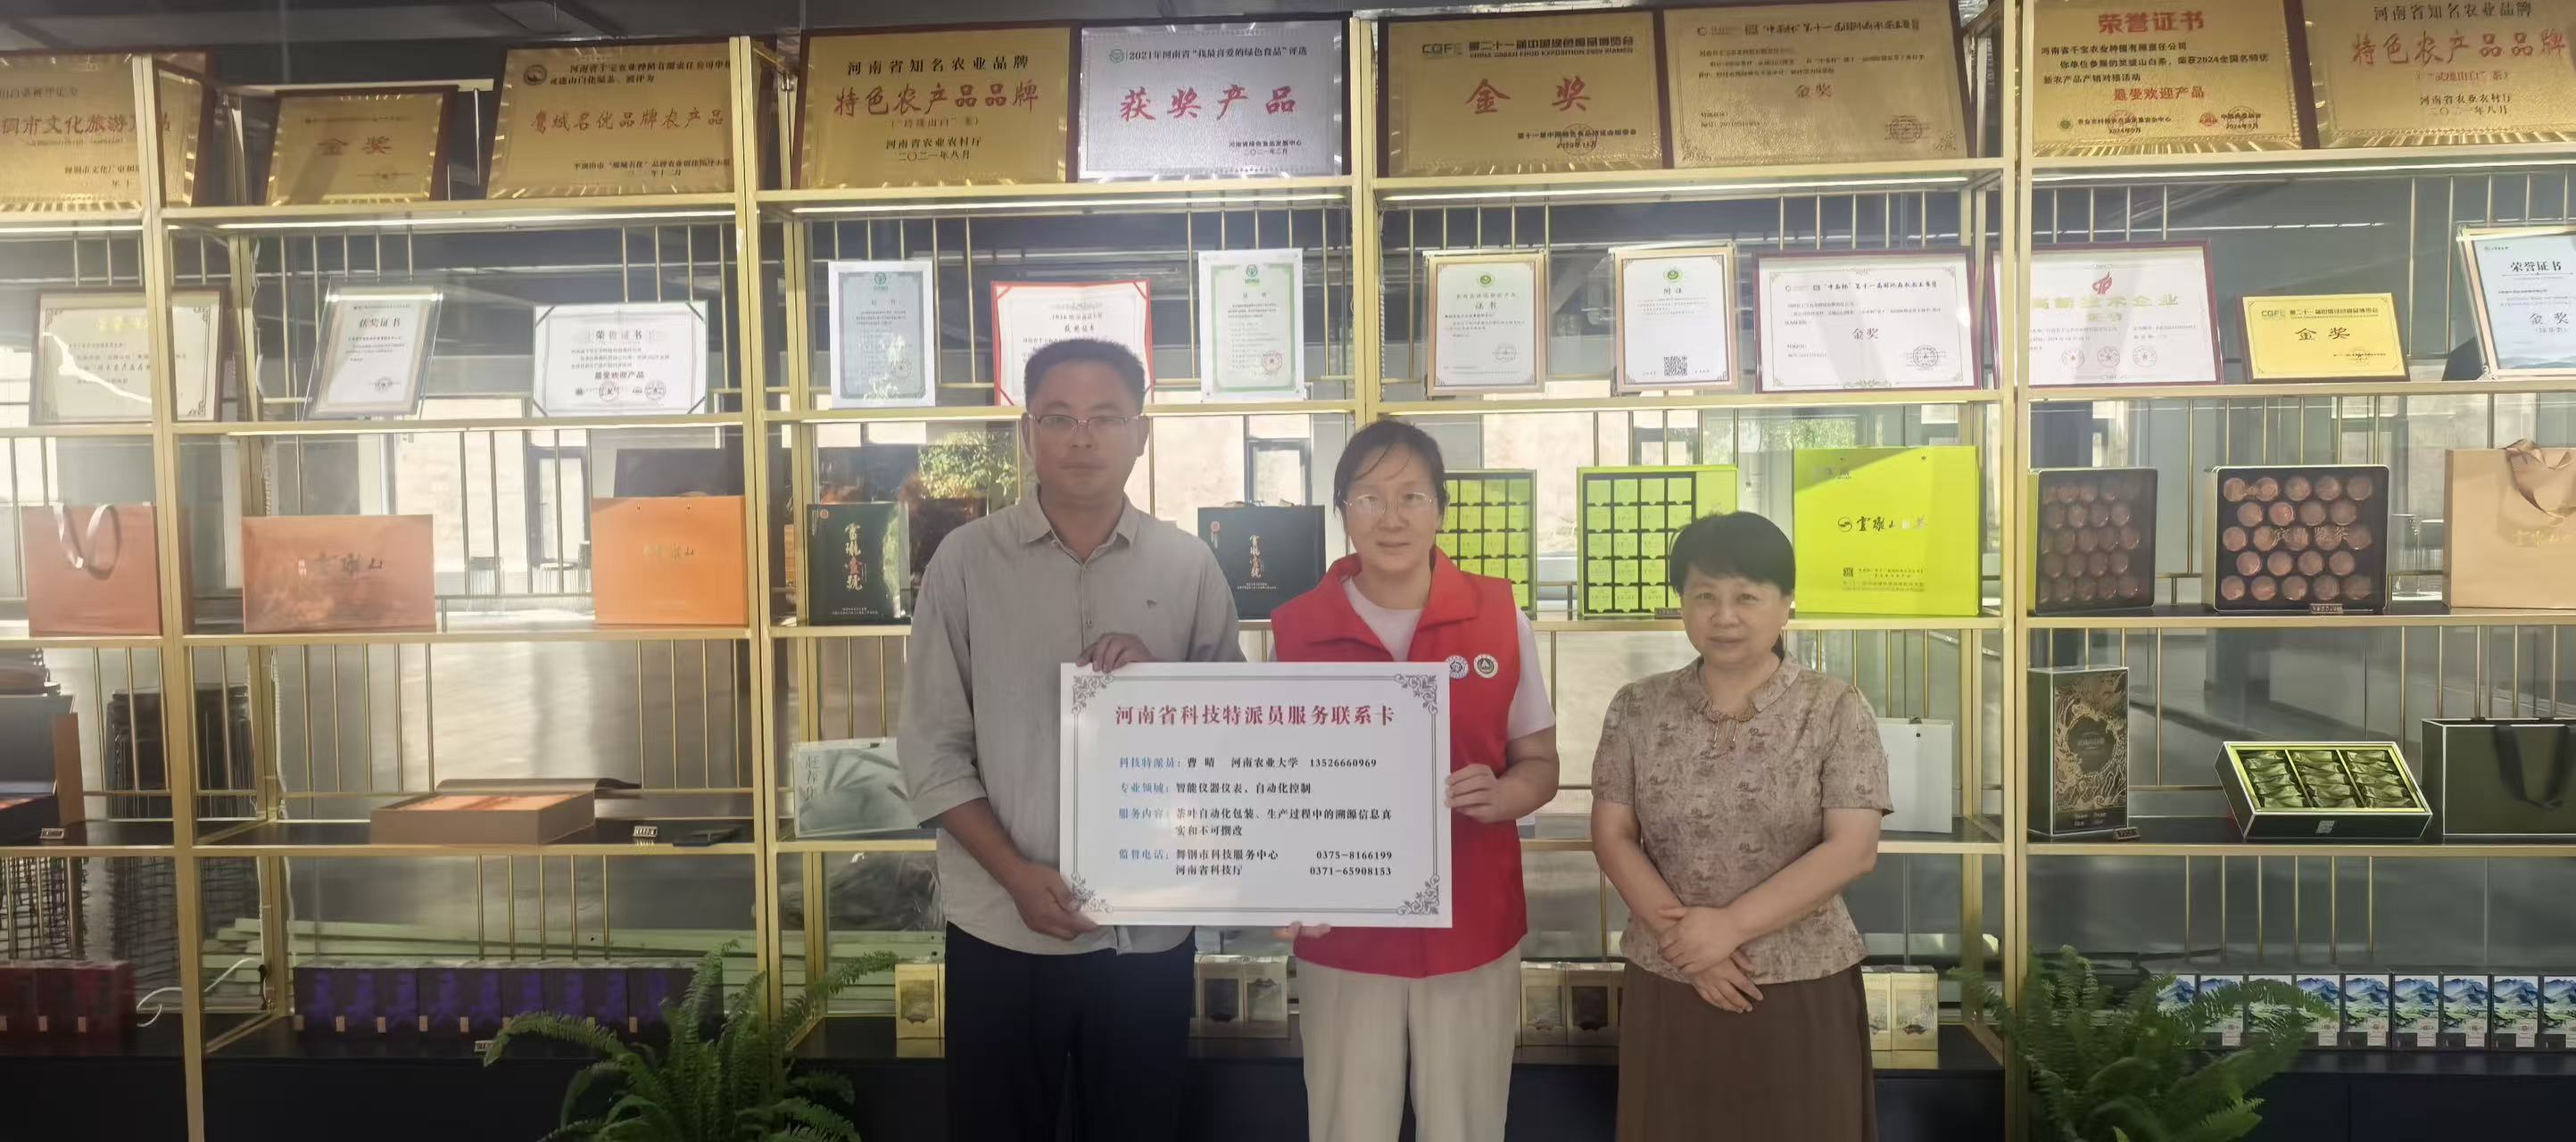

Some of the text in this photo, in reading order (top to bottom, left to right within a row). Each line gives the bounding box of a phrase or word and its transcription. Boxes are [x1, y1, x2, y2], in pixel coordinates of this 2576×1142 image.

[2373, 2, 2532, 21] 河南省知名农业品牌
[2099, 11, 2205, 34] 荣誉证书
[2352, 29, 2566, 65] 特色农产品品牌
[848, 55, 1028, 75] 河南省知名农业品牌
[834, 79, 1038, 117] 特色农产品品牌
[1466, 76, 1591, 114] 金奖
[1795, 84, 1834, 98] 金奖
[2114, 87, 2204, 101] 最受欢迎产品
[1121, 84, 1296, 121] 获奖产品
[531, 107, 724, 133] 鹰城名优品牌农产品
[318, 137, 392, 155] 金奖
[886, 136, 982, 149] 河南省农业农村厅
[2509, 261, 2563, 272] 荣誉证书
[1851, 327, 1879, 340] 金奖
[2294, 327, 2350, 341] 金奖
[1115, 705, 1394, 726] 河南省科技特派员服务联系卡
[1231, 757, 1298, 768] 河南农业大学
[1310, 758, 1377, 767] 13526660969
[1316, 850, 1392, 860] 0375-8166199
[1176, 865, 1391, 876] 河南省科技厅 0371-65908153
